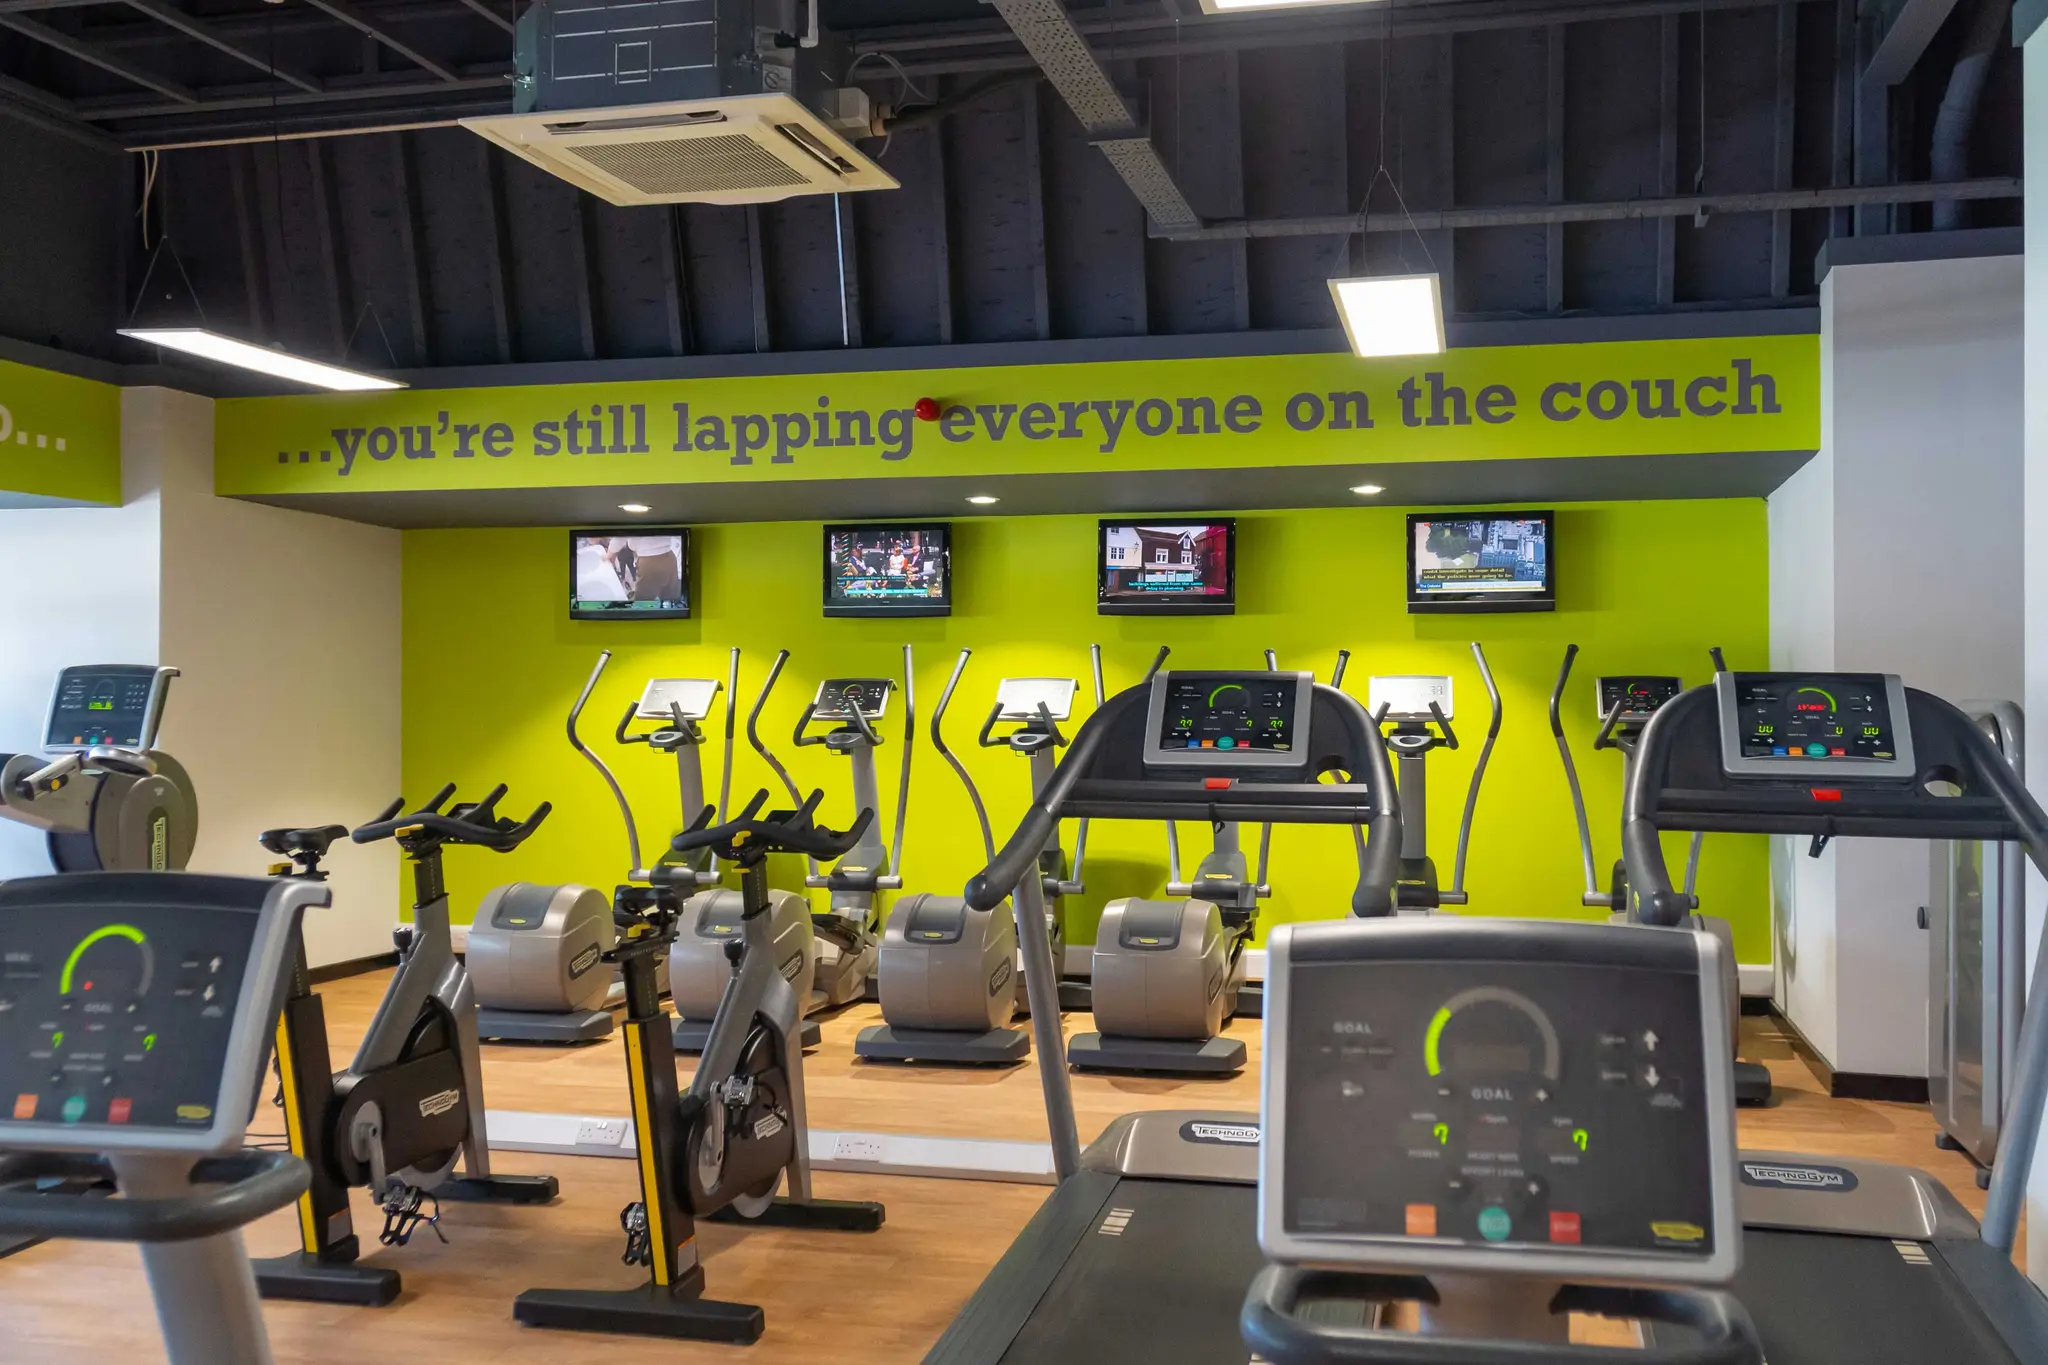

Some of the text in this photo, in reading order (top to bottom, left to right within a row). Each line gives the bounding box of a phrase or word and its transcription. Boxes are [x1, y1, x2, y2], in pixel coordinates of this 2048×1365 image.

[532, 404, 650, 457] still
[673, 397, 917, 466] lapping
[938, 395, 1262, 453] everyone
[1286, 391, 1374, 431] on
[1396, 371, 1516, 427] the
[1540, 359, 1782, 422] couch
[1471, 1087, 1513, 1101] GOAL
